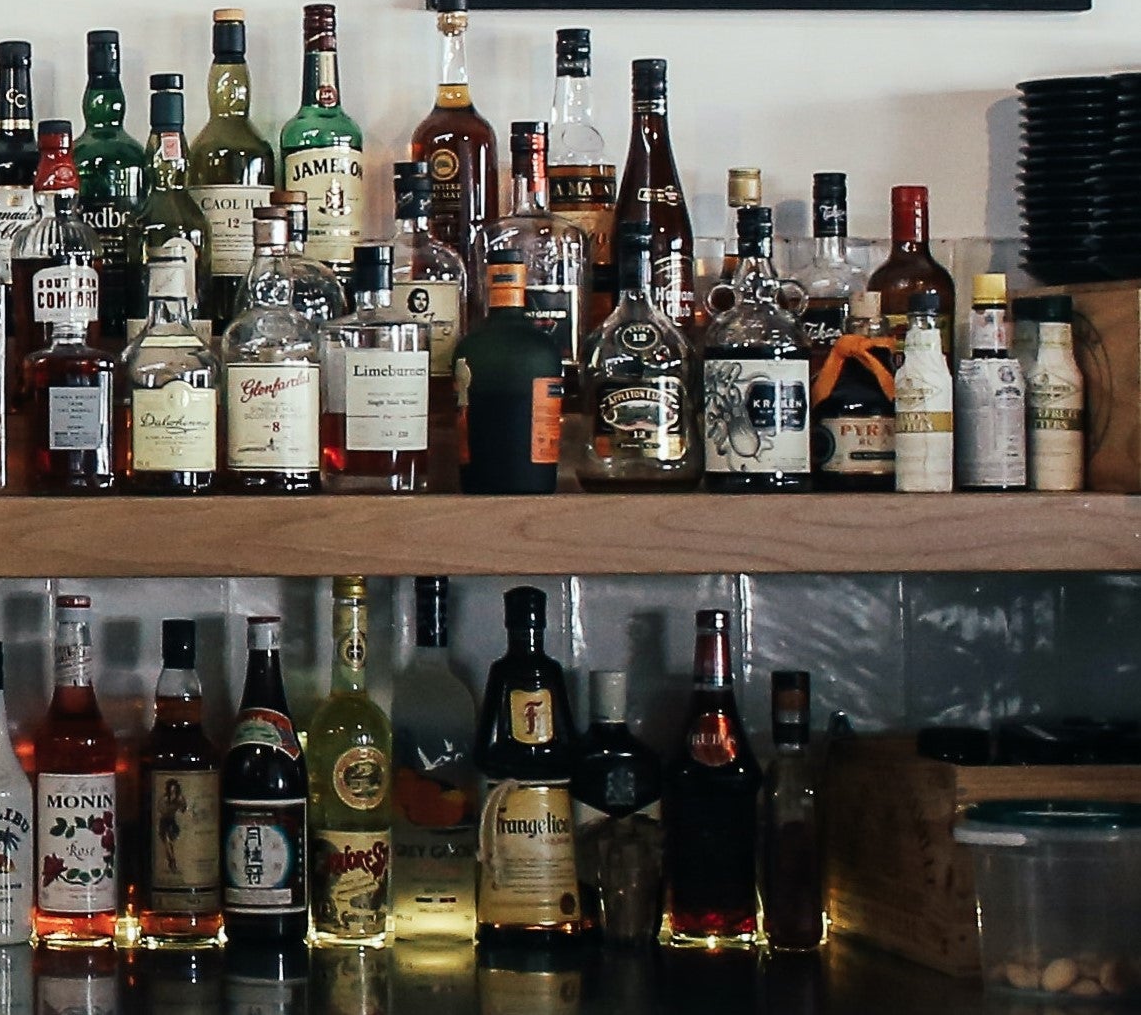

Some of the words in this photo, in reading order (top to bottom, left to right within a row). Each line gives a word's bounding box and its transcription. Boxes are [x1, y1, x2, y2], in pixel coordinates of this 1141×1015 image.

[201, 197, 241, 210] CAOL
[227, 217, 240, 229] 12
[272, 421, 281, 433] 8
[47, 794, 114, 809] MONIN
